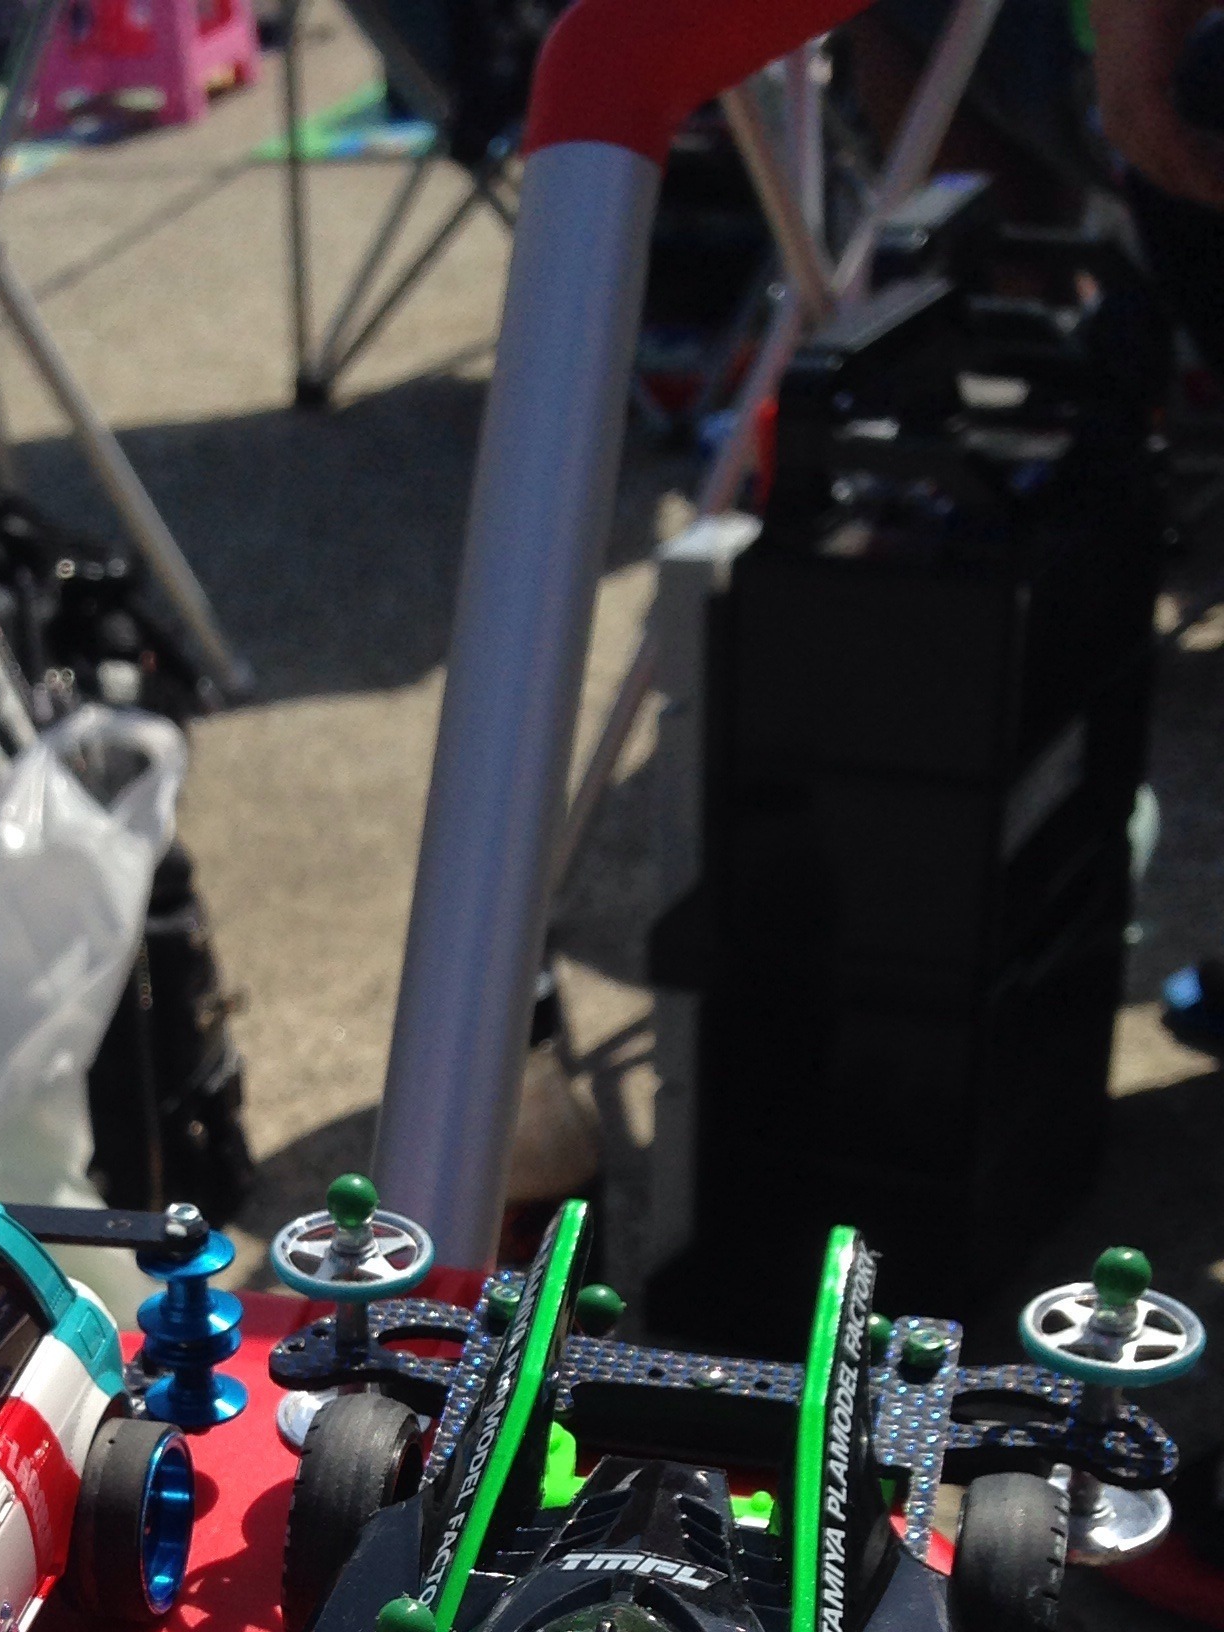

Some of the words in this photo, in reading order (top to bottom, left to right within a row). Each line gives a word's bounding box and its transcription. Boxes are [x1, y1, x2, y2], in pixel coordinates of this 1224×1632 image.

[827, 1361, 859, 1522] PLAMODEL
[843, 1240, 883, 1361] FACTORY
[419, 1511, 466, 1606] FACTO
